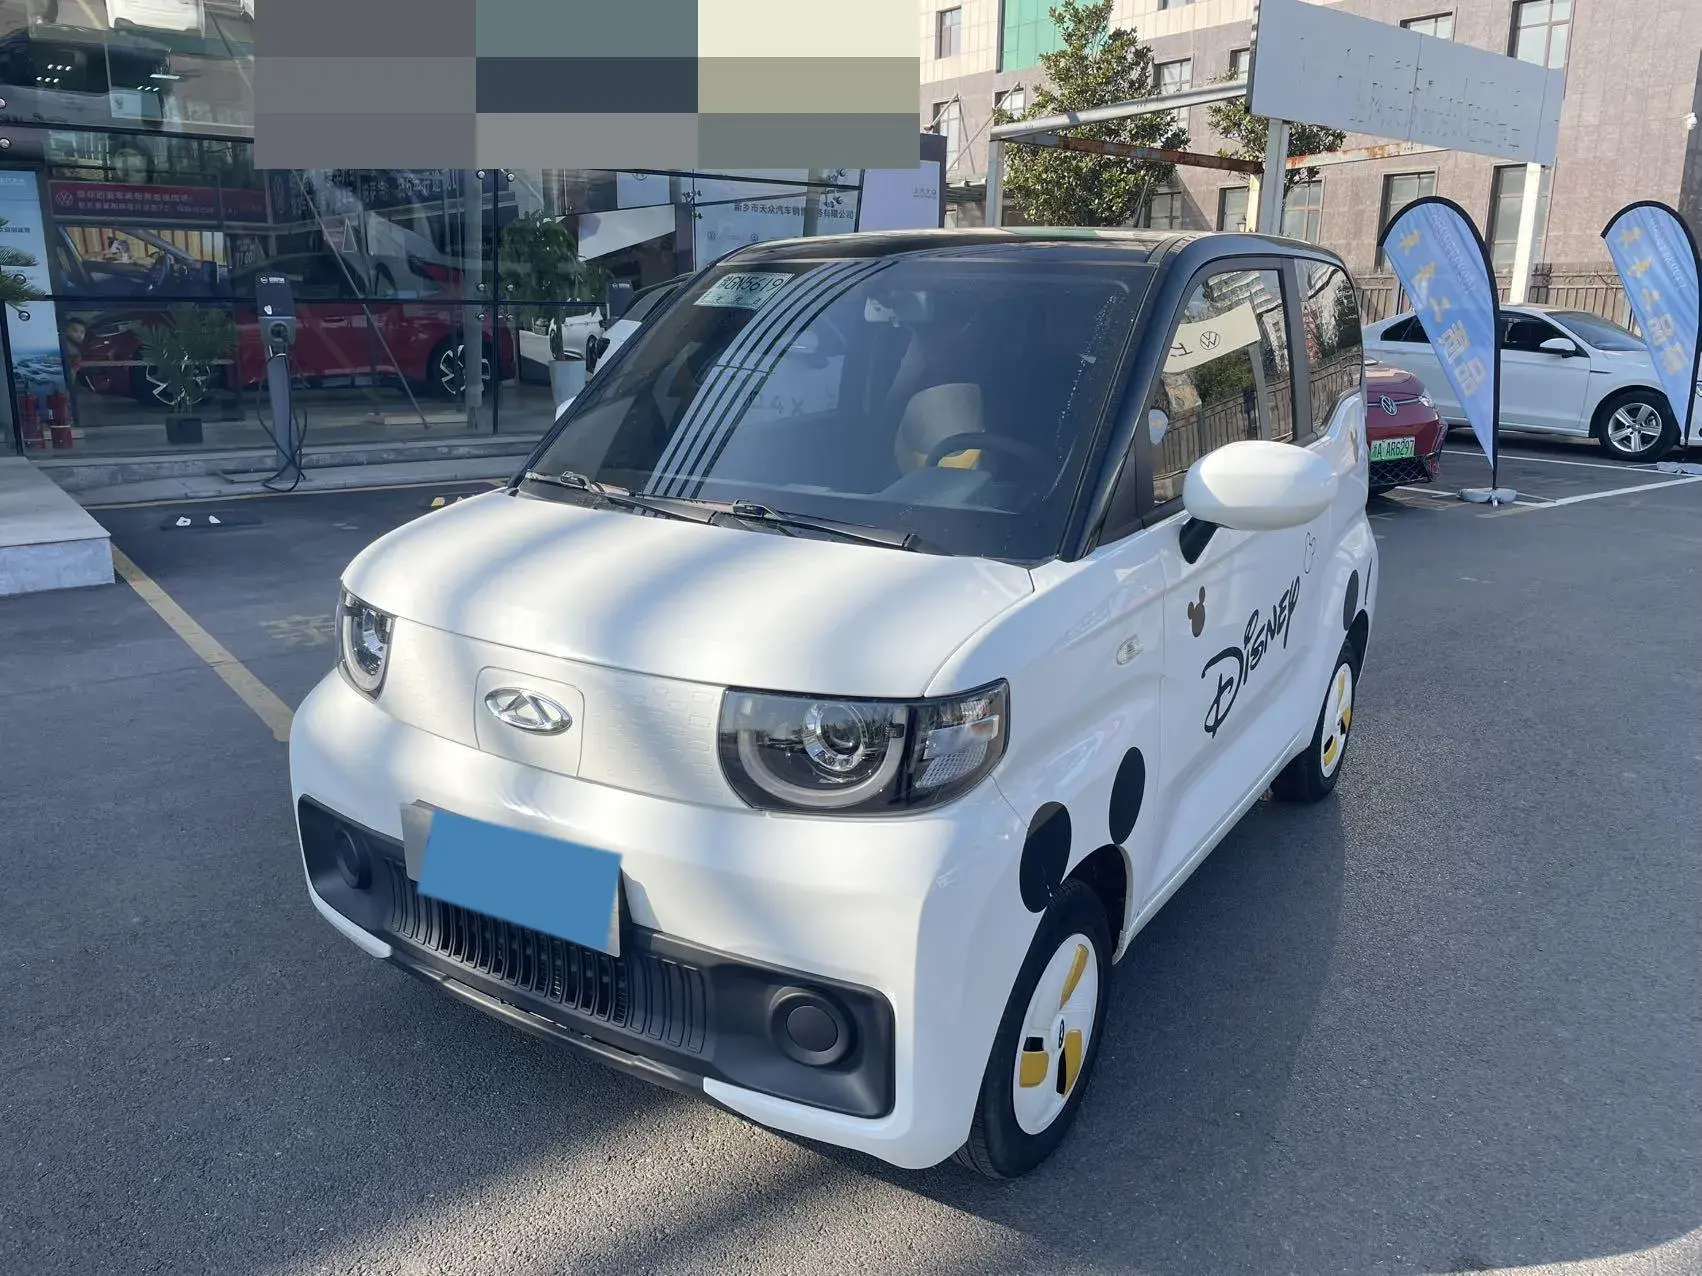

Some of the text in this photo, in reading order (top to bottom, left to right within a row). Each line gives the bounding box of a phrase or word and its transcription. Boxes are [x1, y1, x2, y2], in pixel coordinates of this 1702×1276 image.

[733, 203, 855, 220] 新乡市天众汽车销务有限公司
